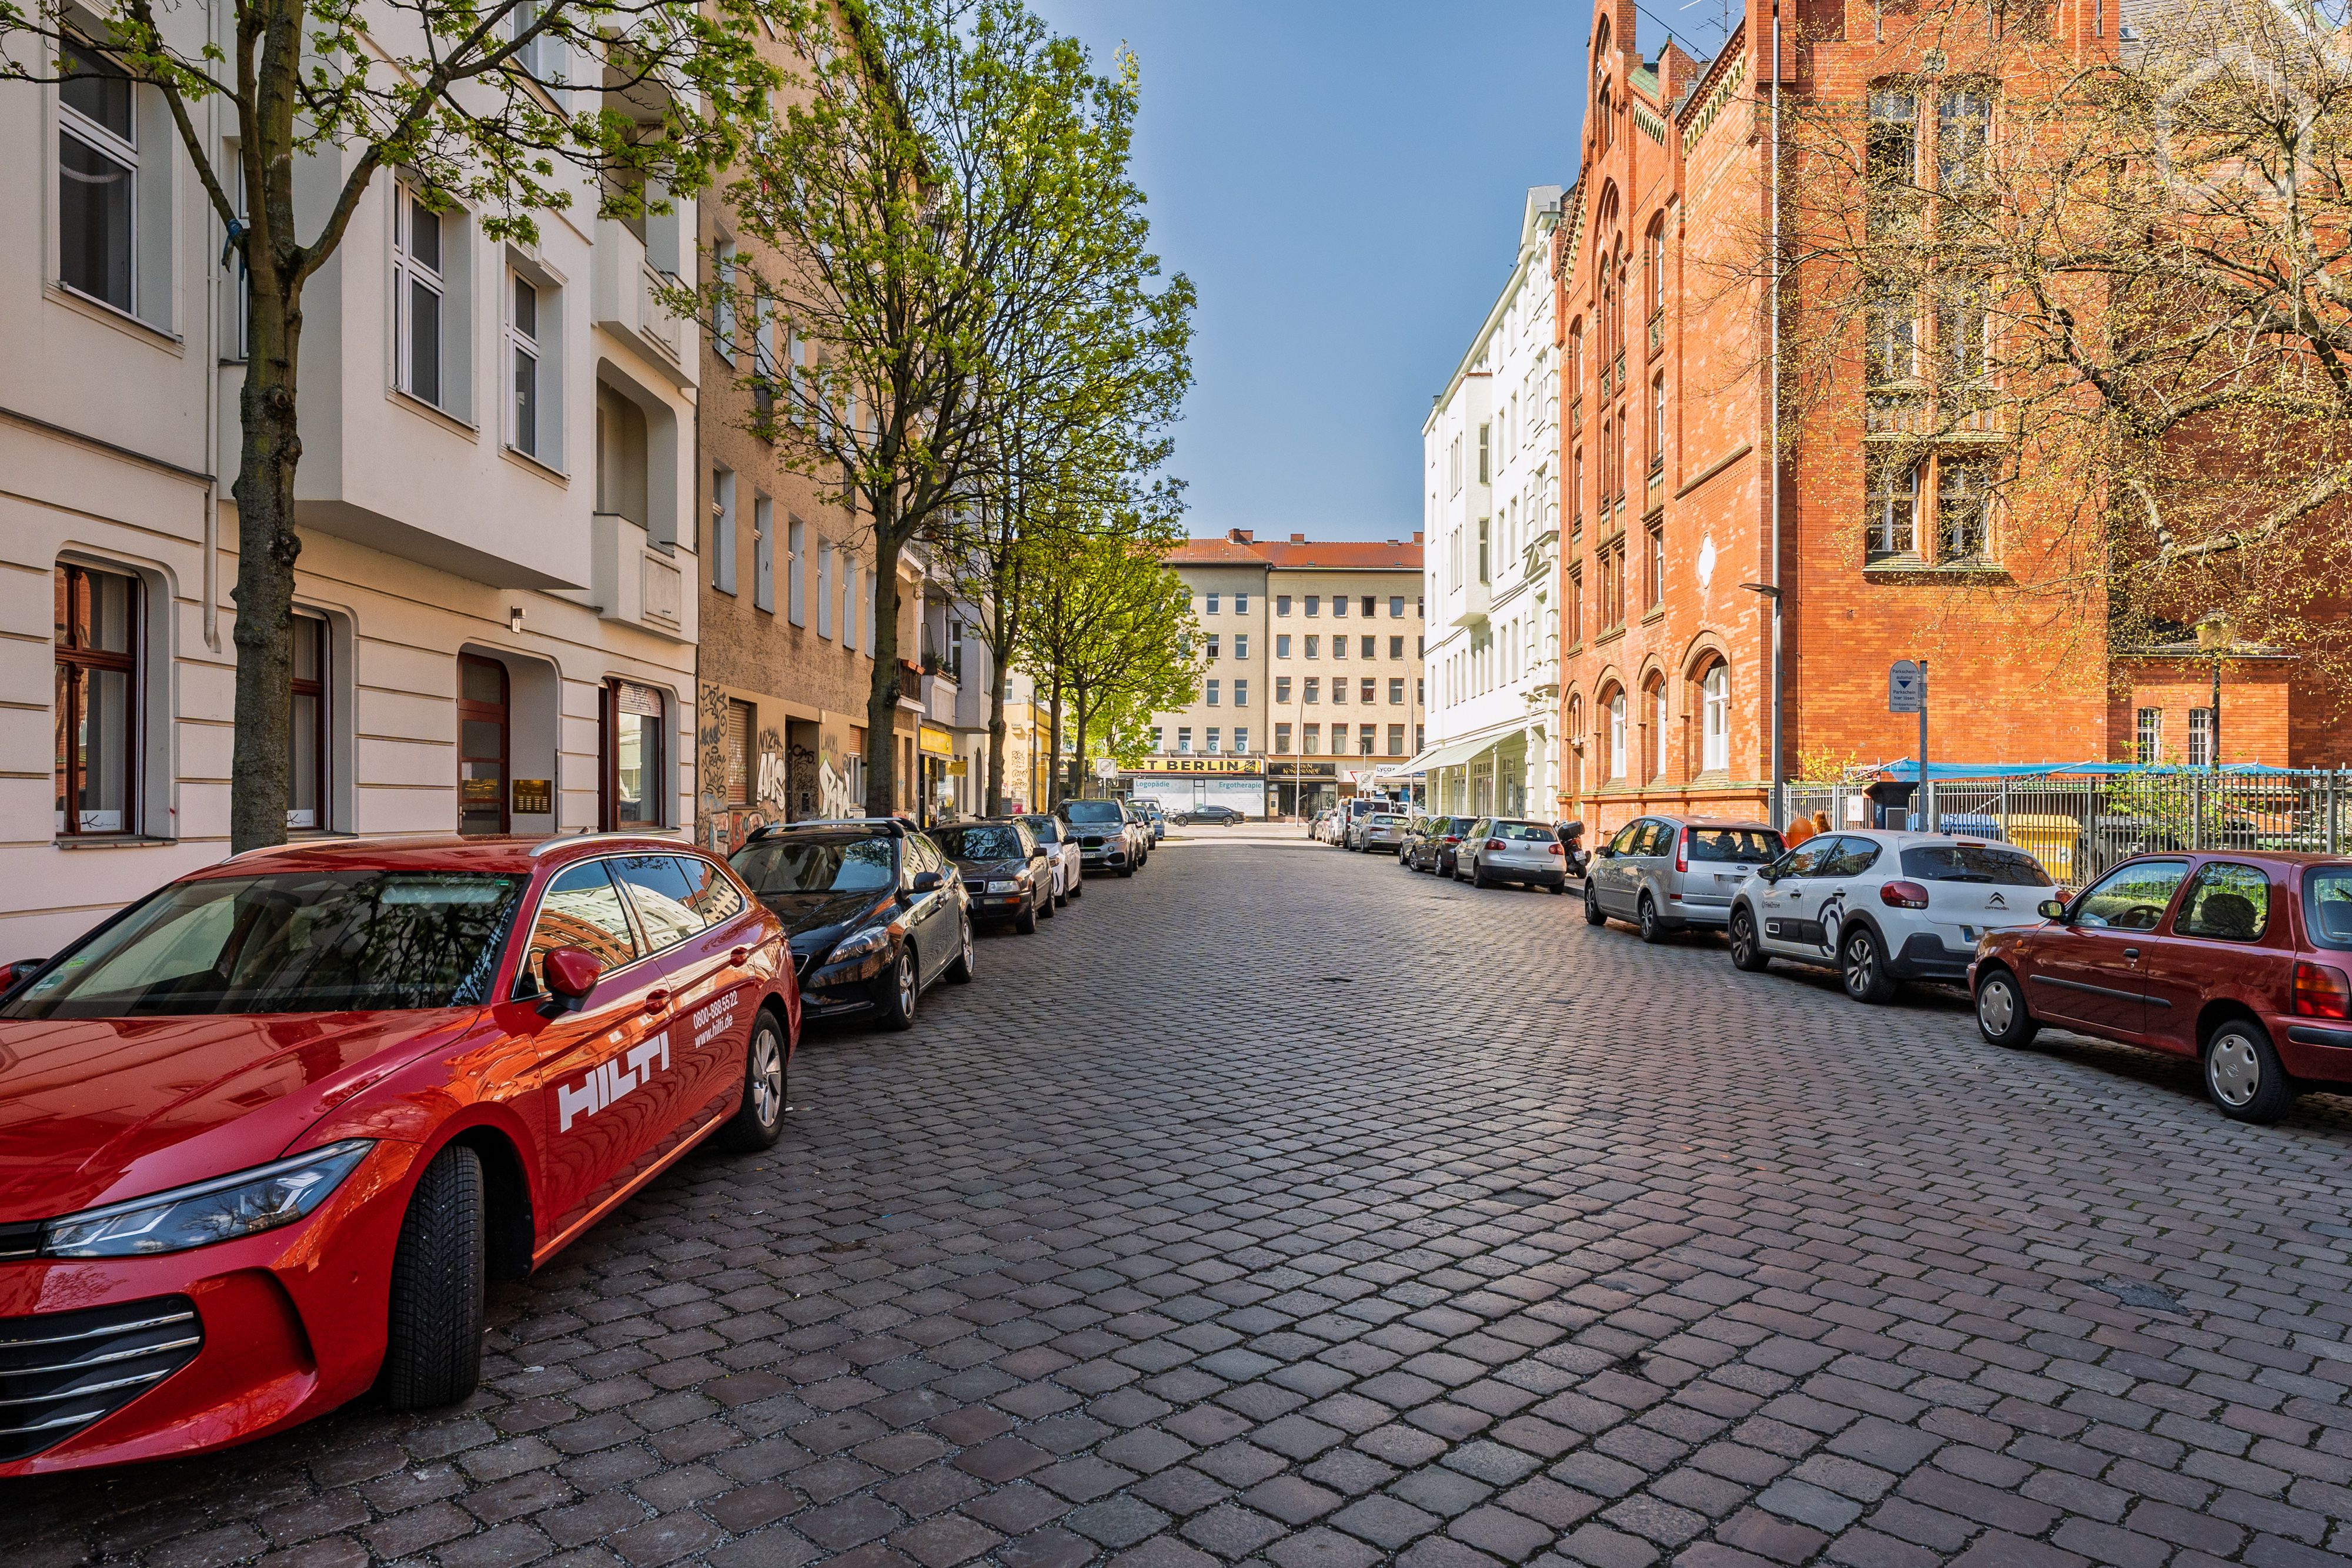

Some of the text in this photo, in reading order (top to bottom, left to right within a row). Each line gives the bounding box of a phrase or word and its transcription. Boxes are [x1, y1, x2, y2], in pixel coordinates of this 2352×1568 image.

[1167, 760, 1239, 771] BERLIN
[1876, 805, 1882, 818] P
[695, 1012, 733, 1049] www.hilti.de
[557, 1030, 670, 1134] HILTI
